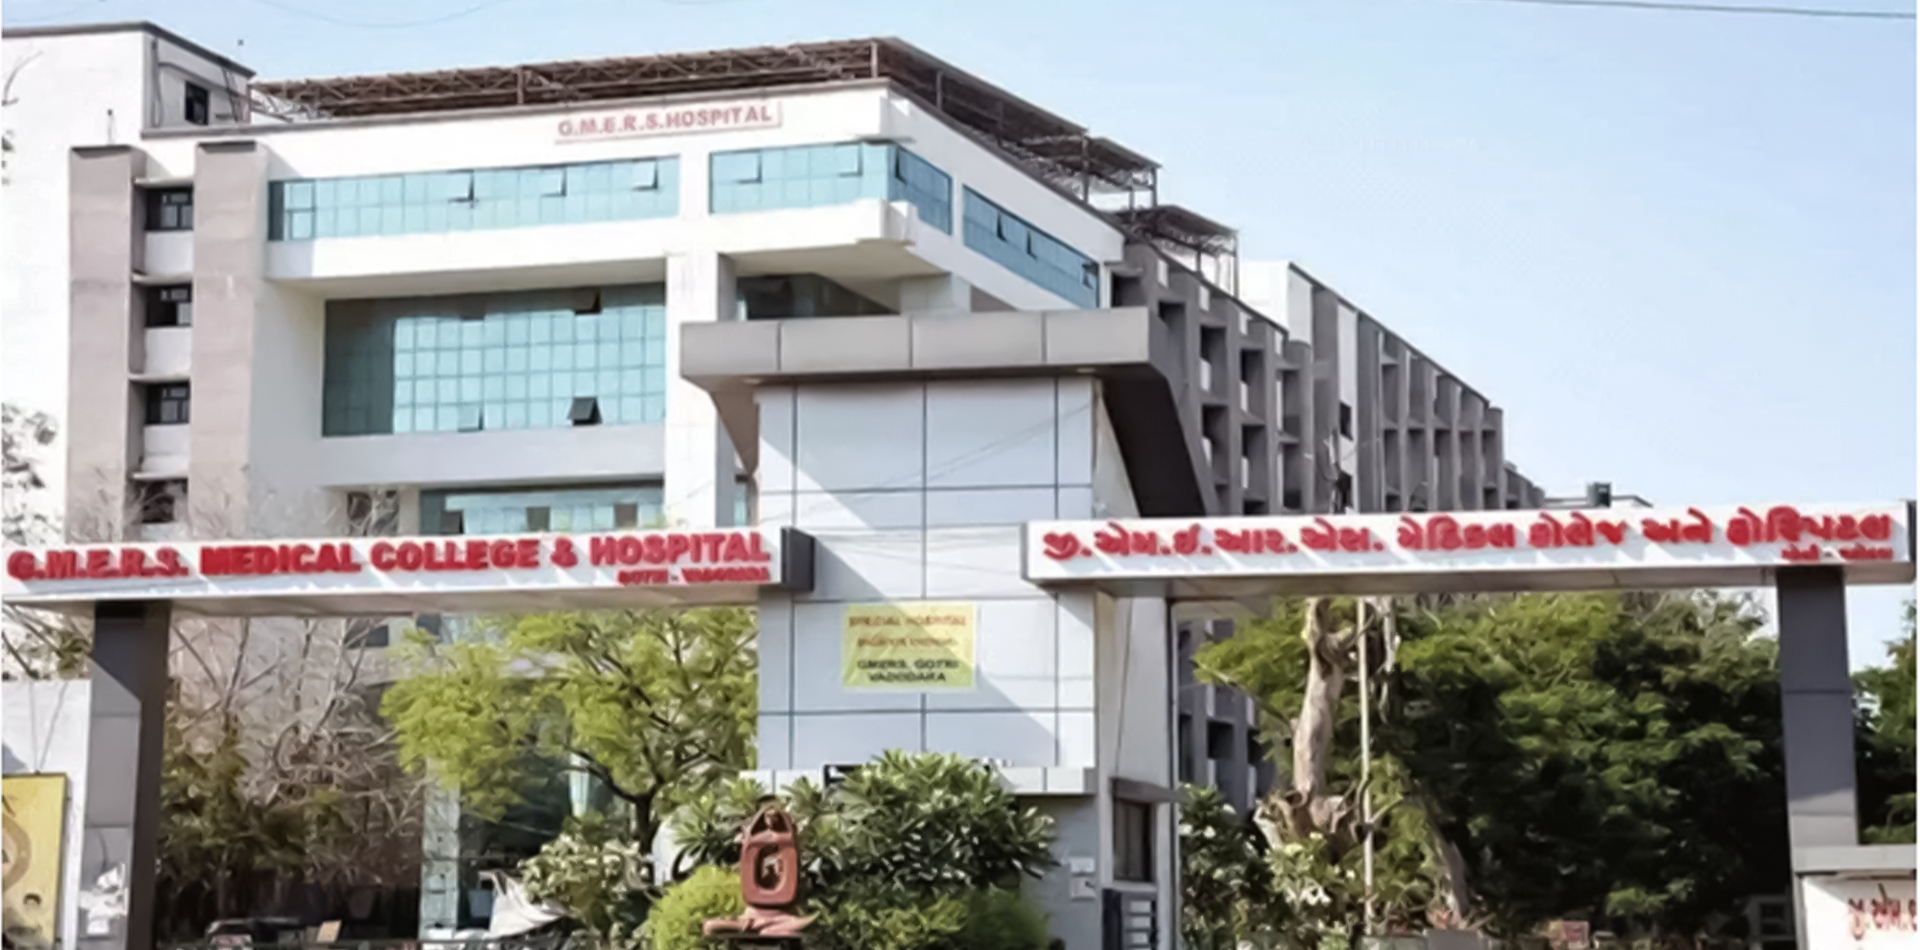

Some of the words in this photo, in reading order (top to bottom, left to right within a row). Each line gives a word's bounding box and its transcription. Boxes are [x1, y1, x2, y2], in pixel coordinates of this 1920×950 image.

[1641, 508, 1714, 543] અને
[7, 548, 190, 581] G.M.E.R.S.
[199, 543, 362, 575] MEDICAL
[369, 538, 540, 572] COLLEGE
[550, 537, 579, 568] &
[588, 531, 771, 566] HOSPITAL
